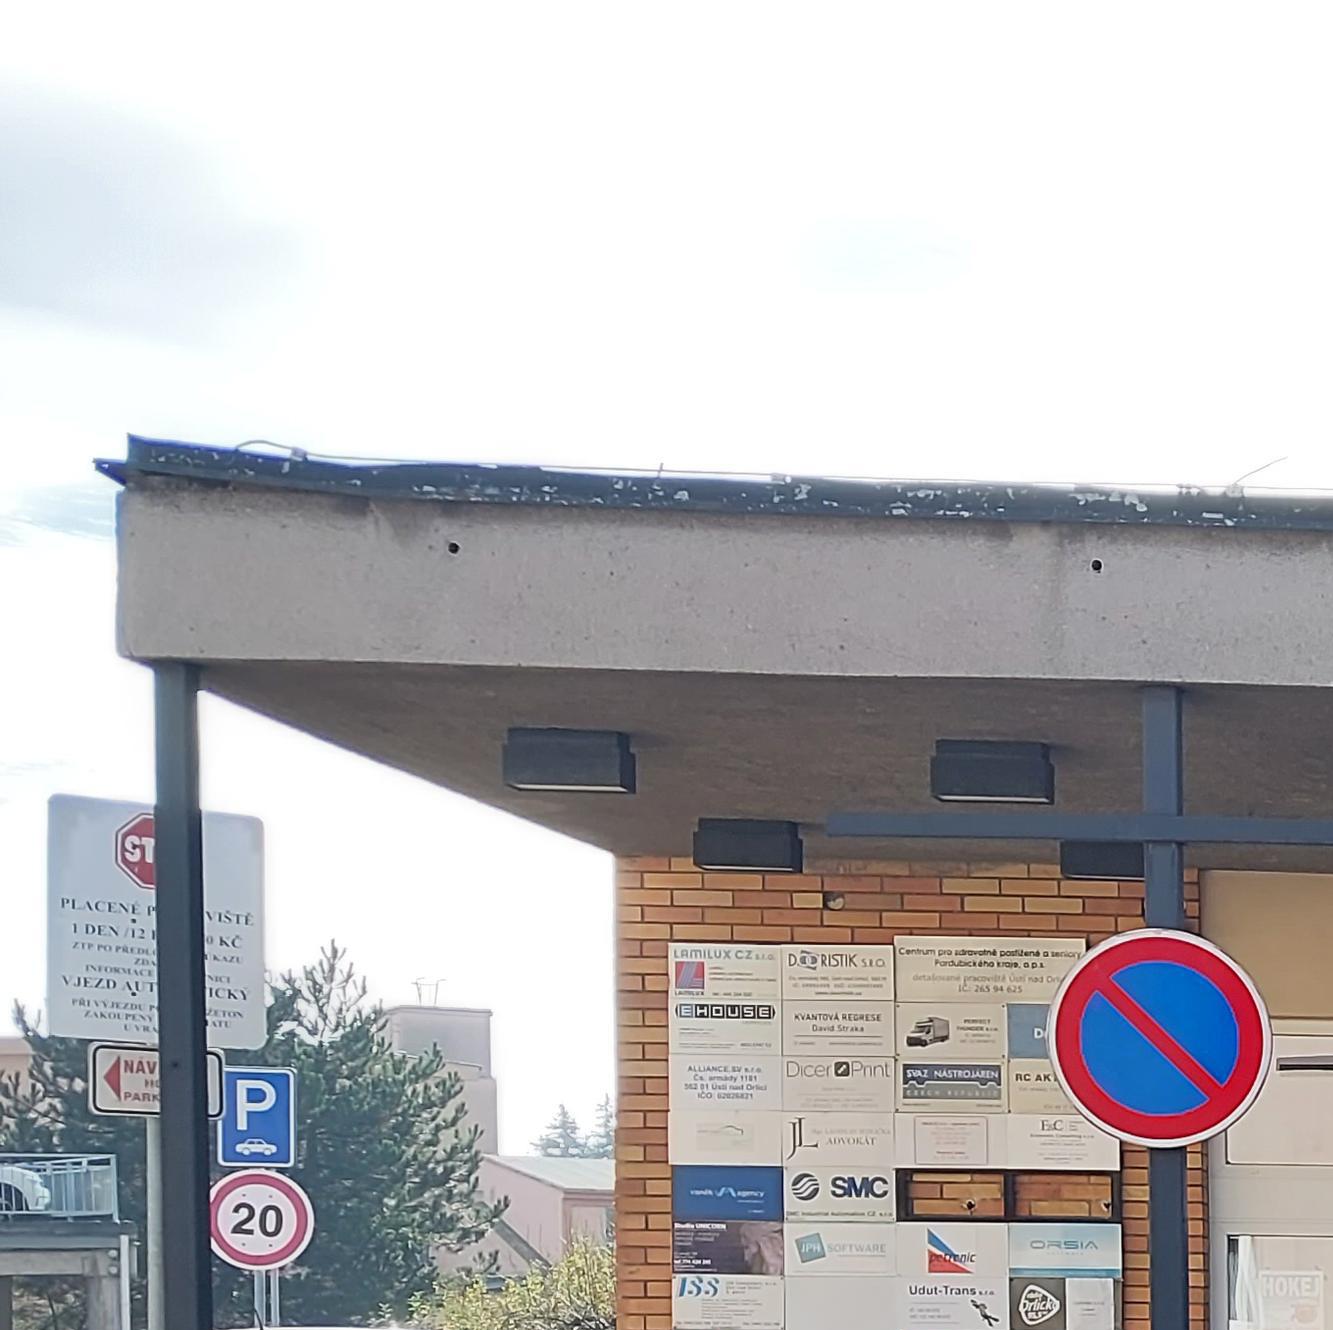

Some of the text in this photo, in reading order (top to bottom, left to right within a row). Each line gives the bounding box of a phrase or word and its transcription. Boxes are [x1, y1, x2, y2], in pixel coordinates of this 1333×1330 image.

[61, 897, 141, 914] PLACENÉ
[85, 924, 118, 937] DEN
[219, 934, 243, 949] KČ
[673, 948, 732, 960] LAMILUX
[734, 950, 753, 960] CZ
[898, 947, 936, 956] Centrum
[938, 949, 953, 957] pro
[934, 959, 995, 968] Pardubického
[62, 975, 117, 990] VJEZD
[1028, 974, 1045, 983] nad
[680, 1004, 770, 1019] EHOUSE
[794, 1012, 882, 1022] KVANTOVÁ REGRESE
[812, 1024, 835, 1032] David
[786, 1060, 891, 1078] Dicer Print
[1015, 1073, 1031, 1082] RC
[236, 1080, 277, 1132] P
[830, 1176, 889, 1198] SMC
[231, 1203, 283, 1237] 20
[827, 1243, 887, 1253] SOFTWARE
[1030, 1240, 1099, 1250] ORSIA
[909, 1285, 977, 1296] Udut-Trans
[1263, 1276, 1320, 1298] HOKEJ
